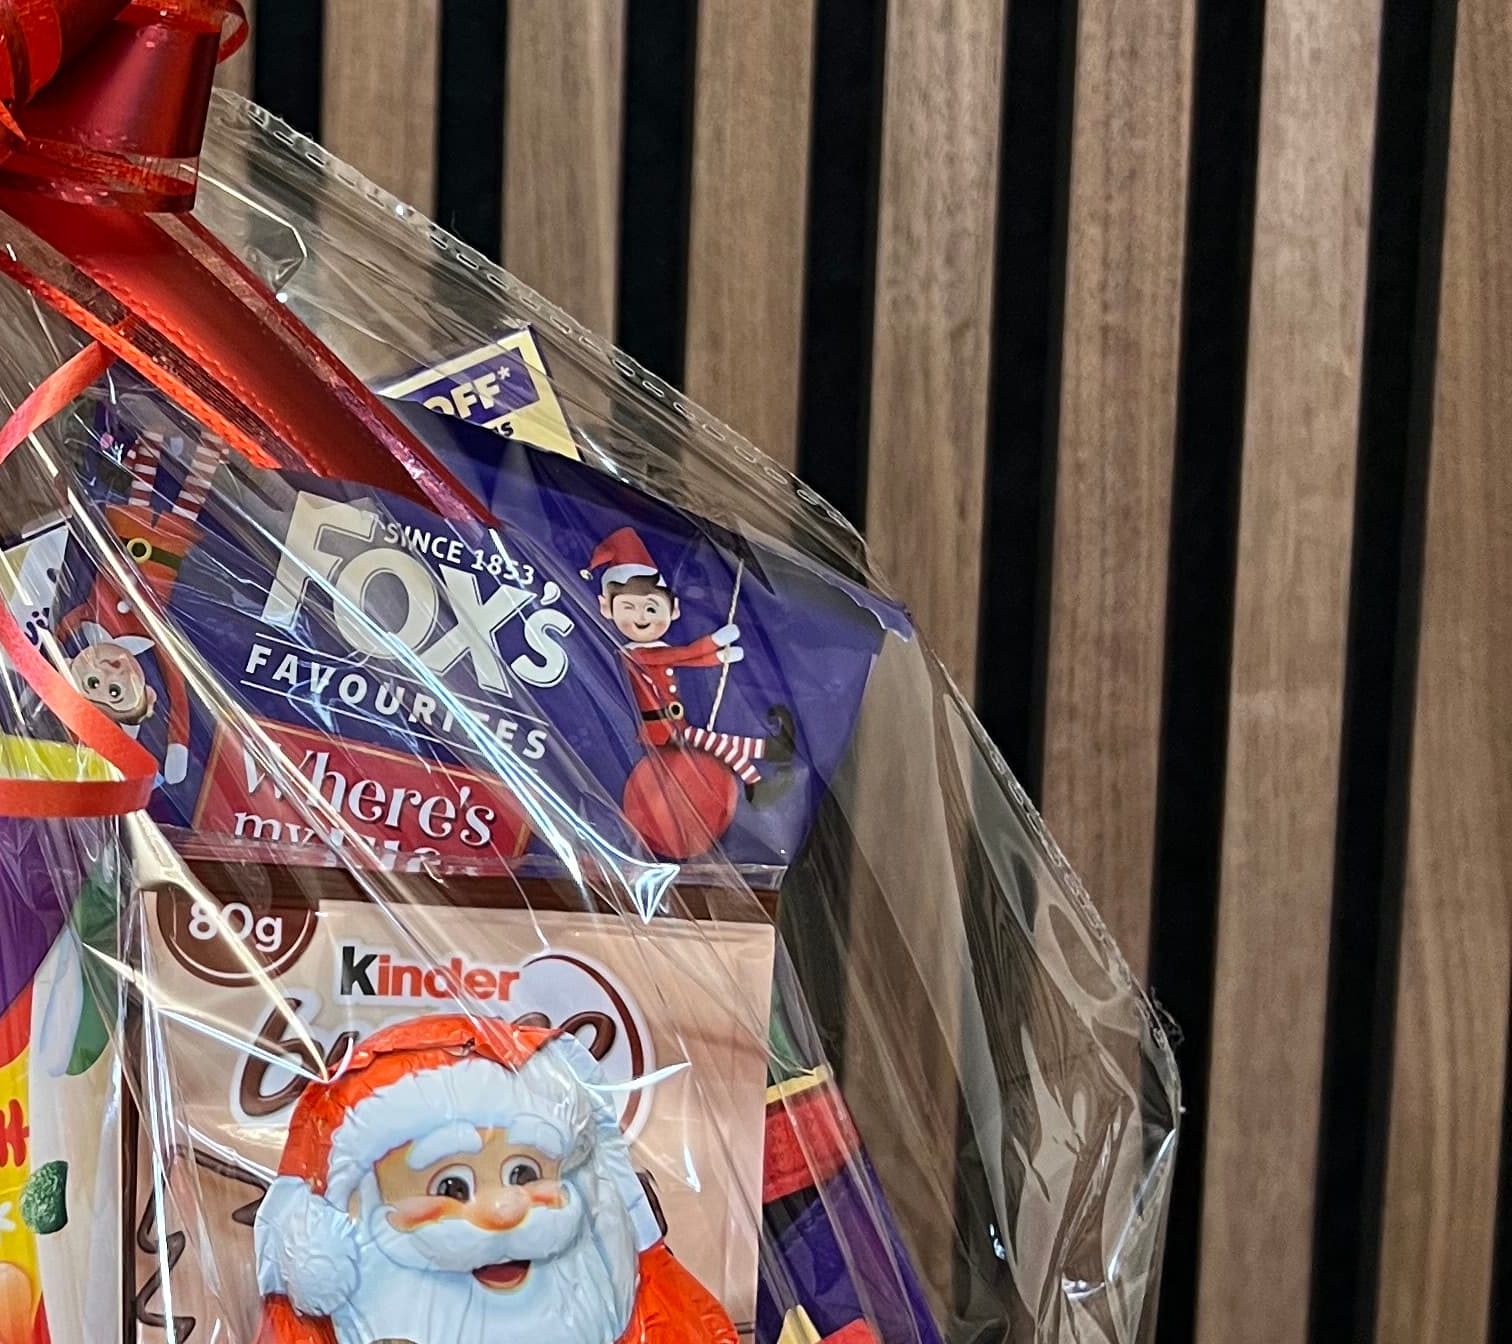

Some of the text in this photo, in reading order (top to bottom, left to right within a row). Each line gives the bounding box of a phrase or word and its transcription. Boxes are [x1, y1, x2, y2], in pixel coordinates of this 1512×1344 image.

[261, 491, 576, 698] FOX'S
[383, 523, 535, 586] SINCE 1853
[242, 744, 495, 846] Where's
[188, 901, 283, 953] 80g
